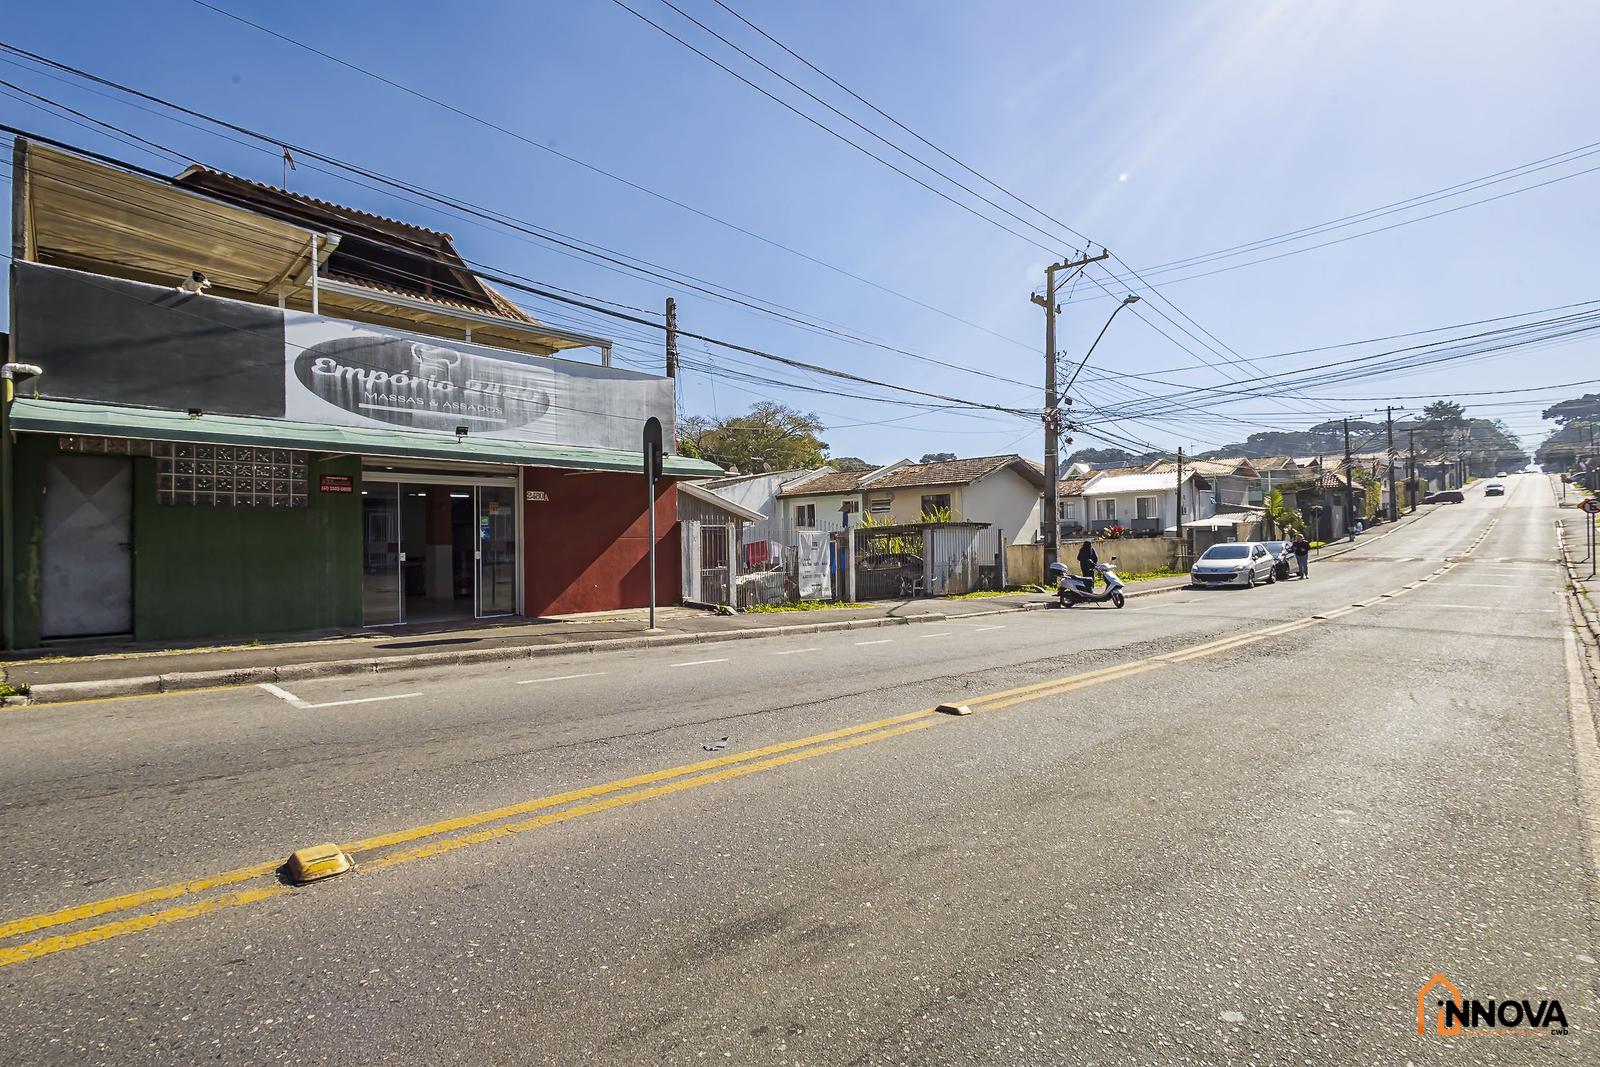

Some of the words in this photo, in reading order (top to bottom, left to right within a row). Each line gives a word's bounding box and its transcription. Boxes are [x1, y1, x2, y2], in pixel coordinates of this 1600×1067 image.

[364, 392, 424, 405] MASSAS
[429, 399, 439, 407] &
[442, 401, 504, 416] ASSADOS
